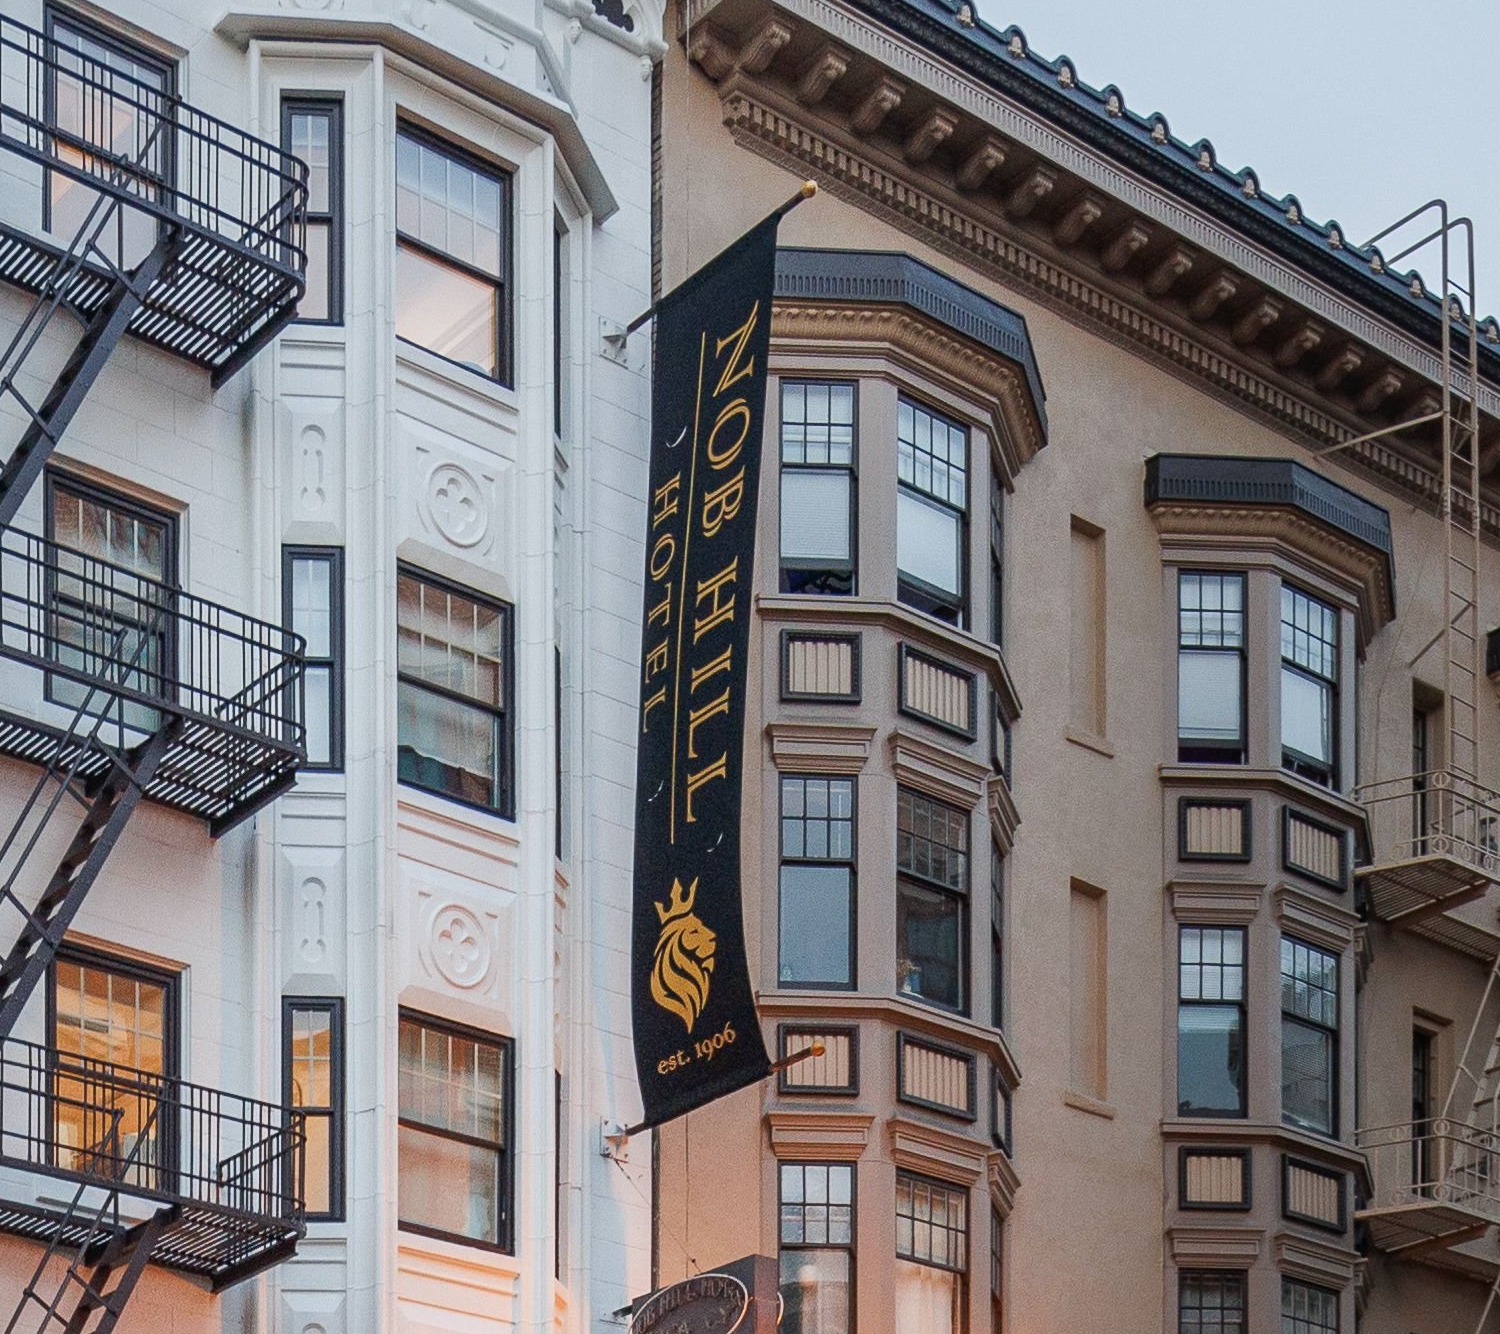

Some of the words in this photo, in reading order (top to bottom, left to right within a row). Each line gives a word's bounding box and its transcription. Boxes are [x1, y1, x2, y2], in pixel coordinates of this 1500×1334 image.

[703, 299, 760, 538] NOB
[642, 471, 682, 734] HOTEL
[686, 555, 739, 824] HILL
[657, 1050, 690, 1075] est.
[694, 1021, 736, 1061] 1906
